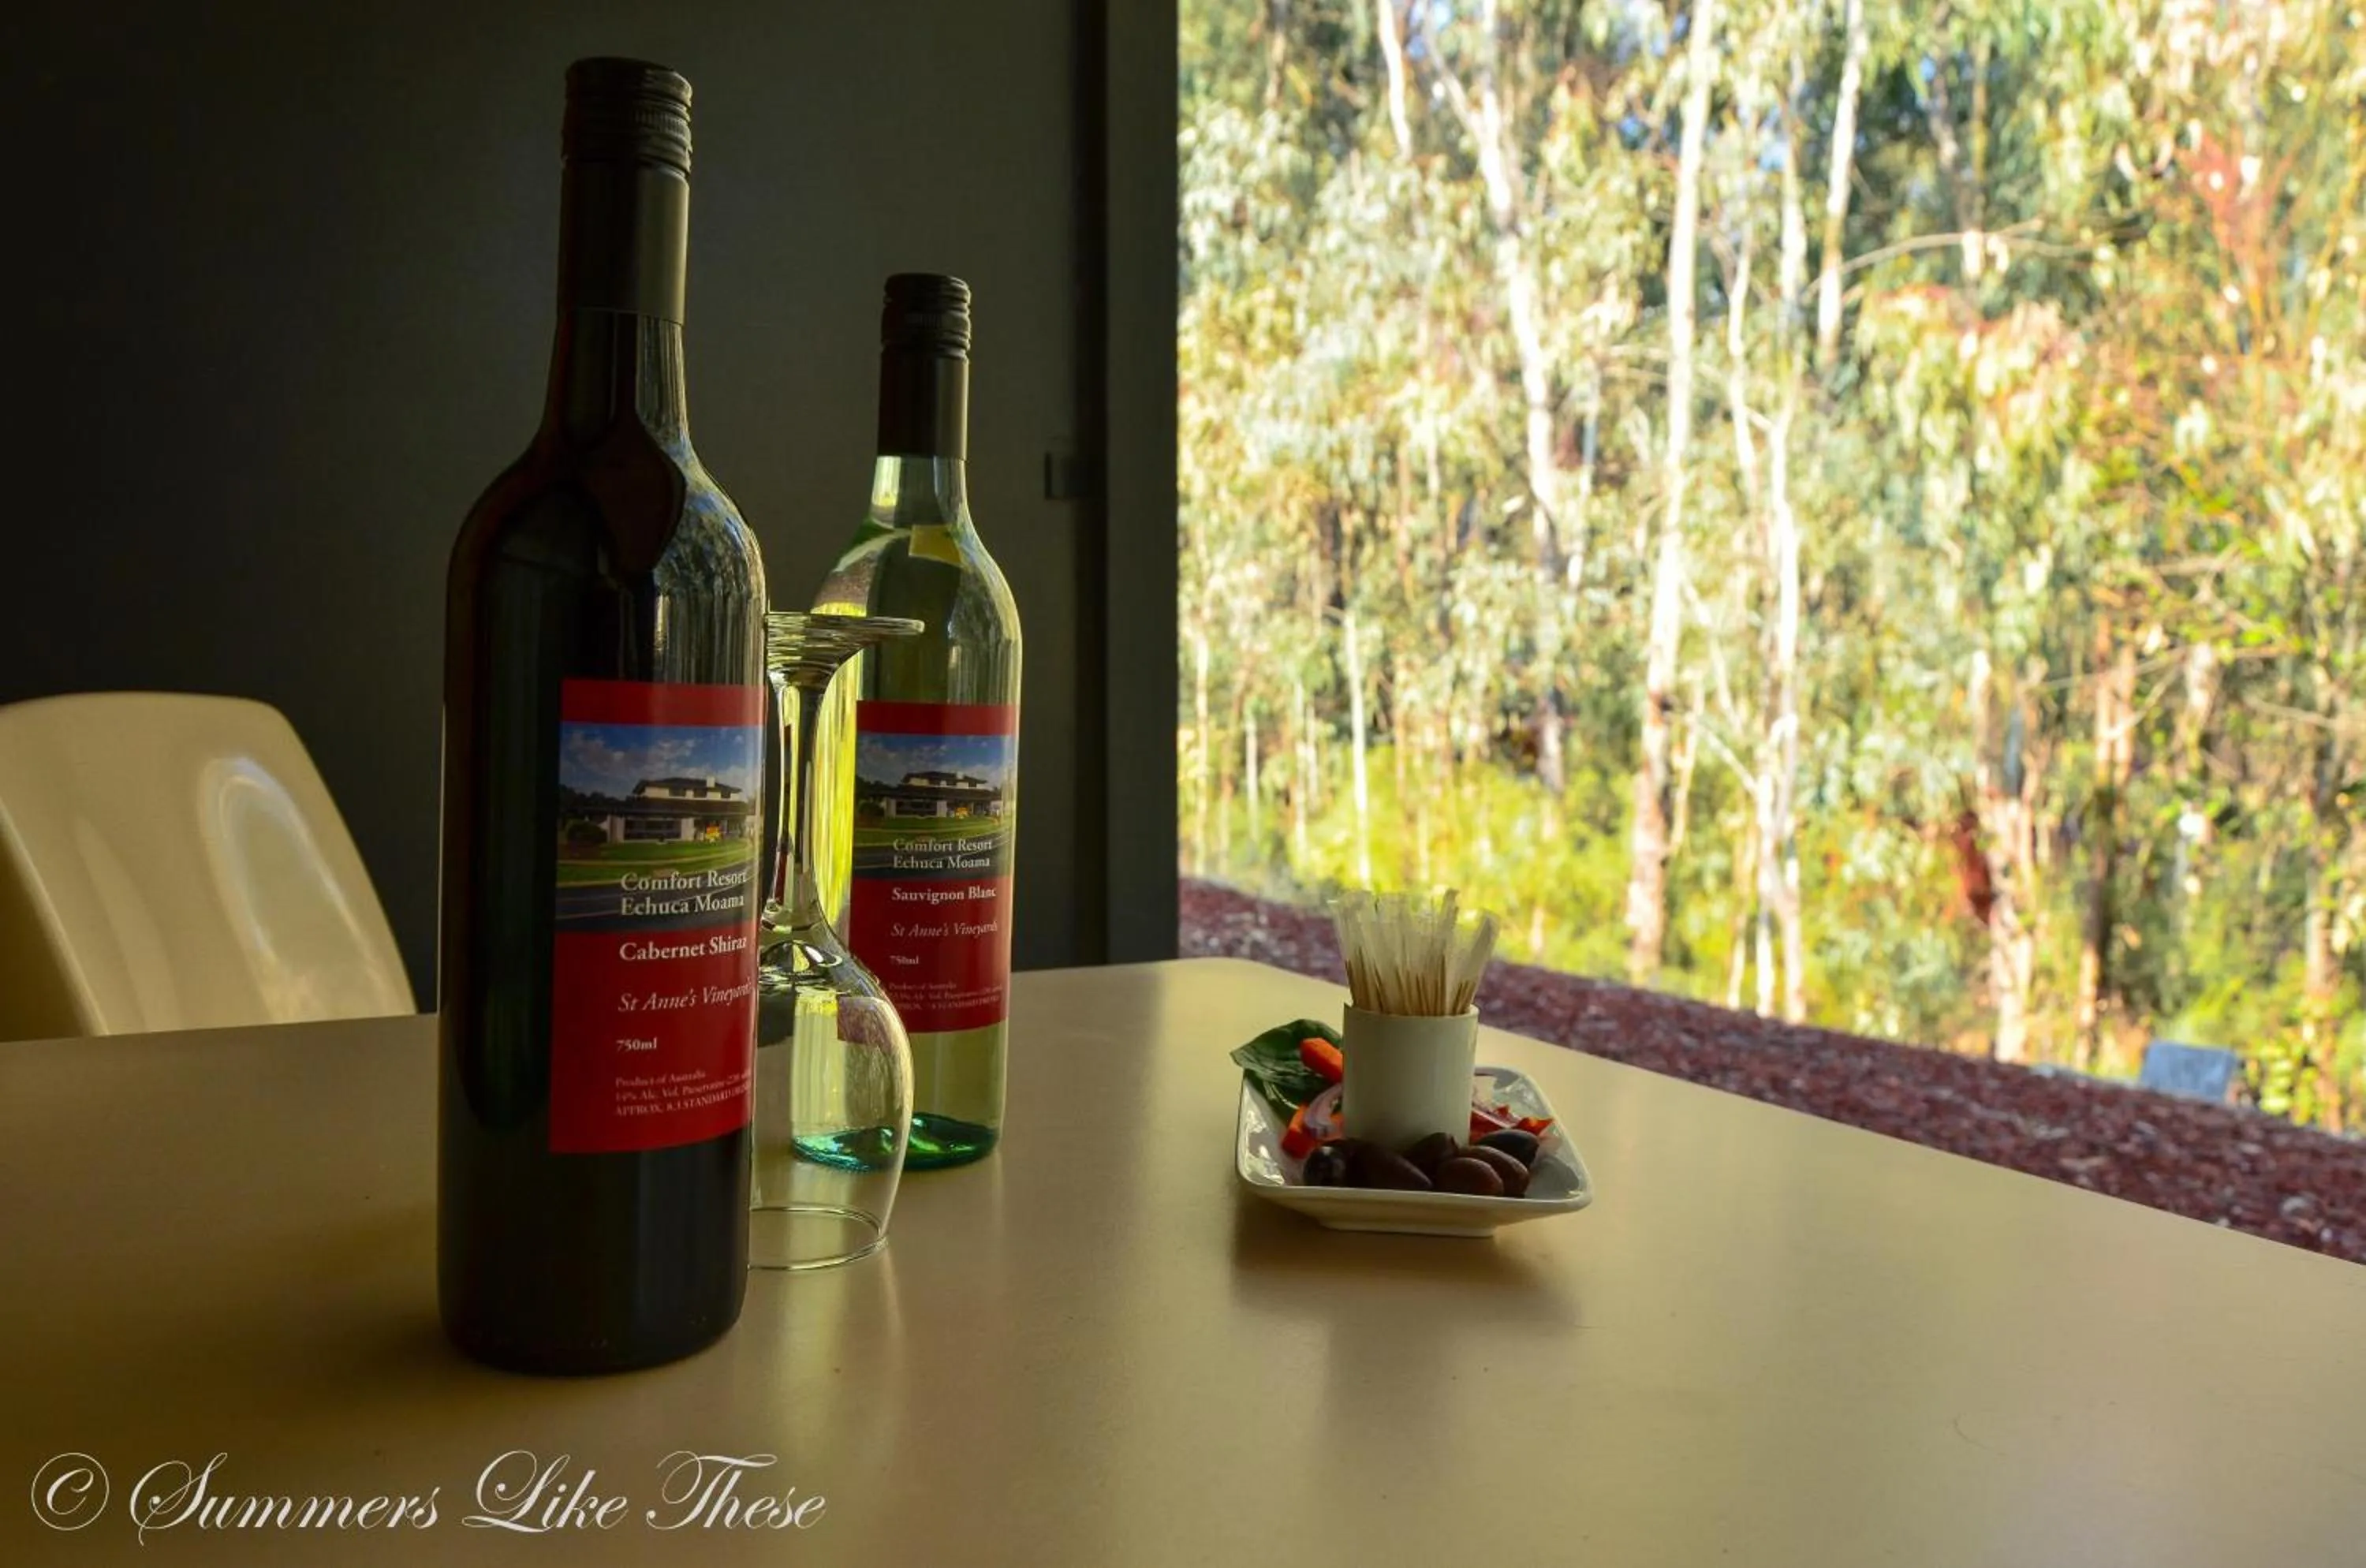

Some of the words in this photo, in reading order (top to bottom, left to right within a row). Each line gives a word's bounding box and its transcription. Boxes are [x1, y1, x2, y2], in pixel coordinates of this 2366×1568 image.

[893, 838, 953, 852] Comfort
[957, 838, 992, 851] Resort
[893, 855, 943, 869] Echuca
[947, 856, 991, 868] Moama
[620, 871, 701, 892] Comfort
[707, 869, 748, 888] Resort
[621, 894, 689, 916] Echuca
[693, 894, 745, 913] Moama
[891, 887, 965, 905] Sauvignon
[968, 884, 997, 900] Blanc
[890, 923, 905, 937] St
[908, 922, 949, 938] Anne's
[619, 941, 705, 961] Cabernet
[709, 935, 748, 954] Shiraz
[618, 992, 639, 1012] St
[642, 987, 696, 1010] Anne's
[616, 1037, 658, 1052] 750ml
